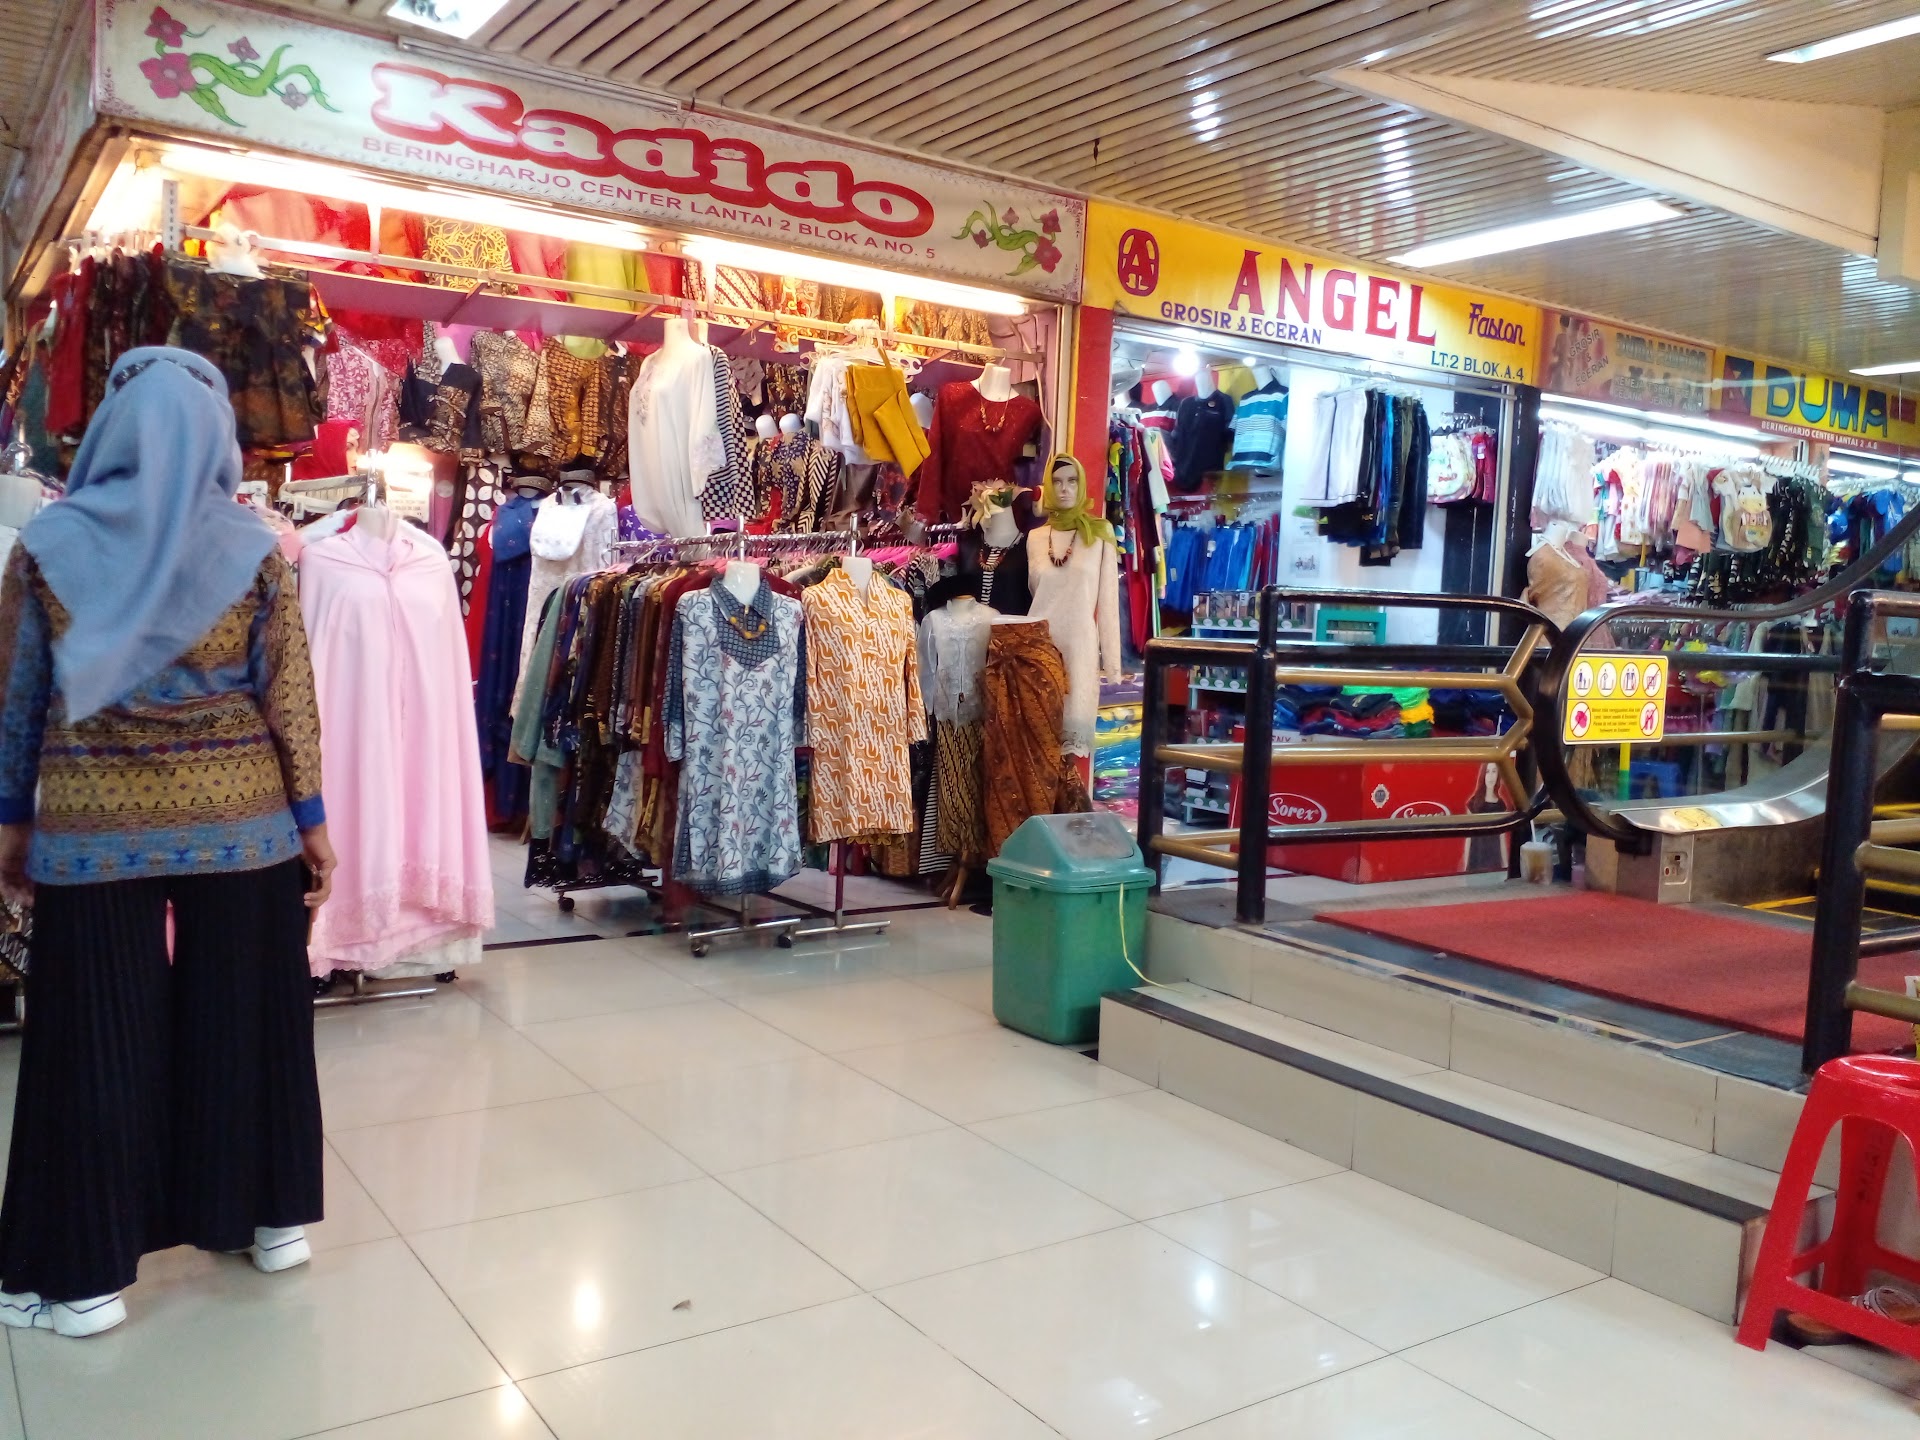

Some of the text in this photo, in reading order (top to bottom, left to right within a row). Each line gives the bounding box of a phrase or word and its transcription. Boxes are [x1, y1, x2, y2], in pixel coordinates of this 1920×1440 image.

[371, 62, 935, 237] Kadido
[362, 135, 936, 259] BERINGHARJO CENTER LANTAI 2 BLOK A NO. 5
[1228, 249, 1437, 347] ANGEL
[1160, 300, 1232, 330] GROSIR
[1250, 318, 1322, 346] ECERAN
[1569, 328, 1600, 358] GROSIR
[1575, 355, 1609, 387] ECERAN
[1766, 364, 1888, 438] DUMA
[1761, 420, 1811, 437] BERINGHARJO
[1811, 429, 1835, 441] CENTER
[1835, 434, 1859, 447] LANTAI
[1269, 797, 1315, 821] Sorex
